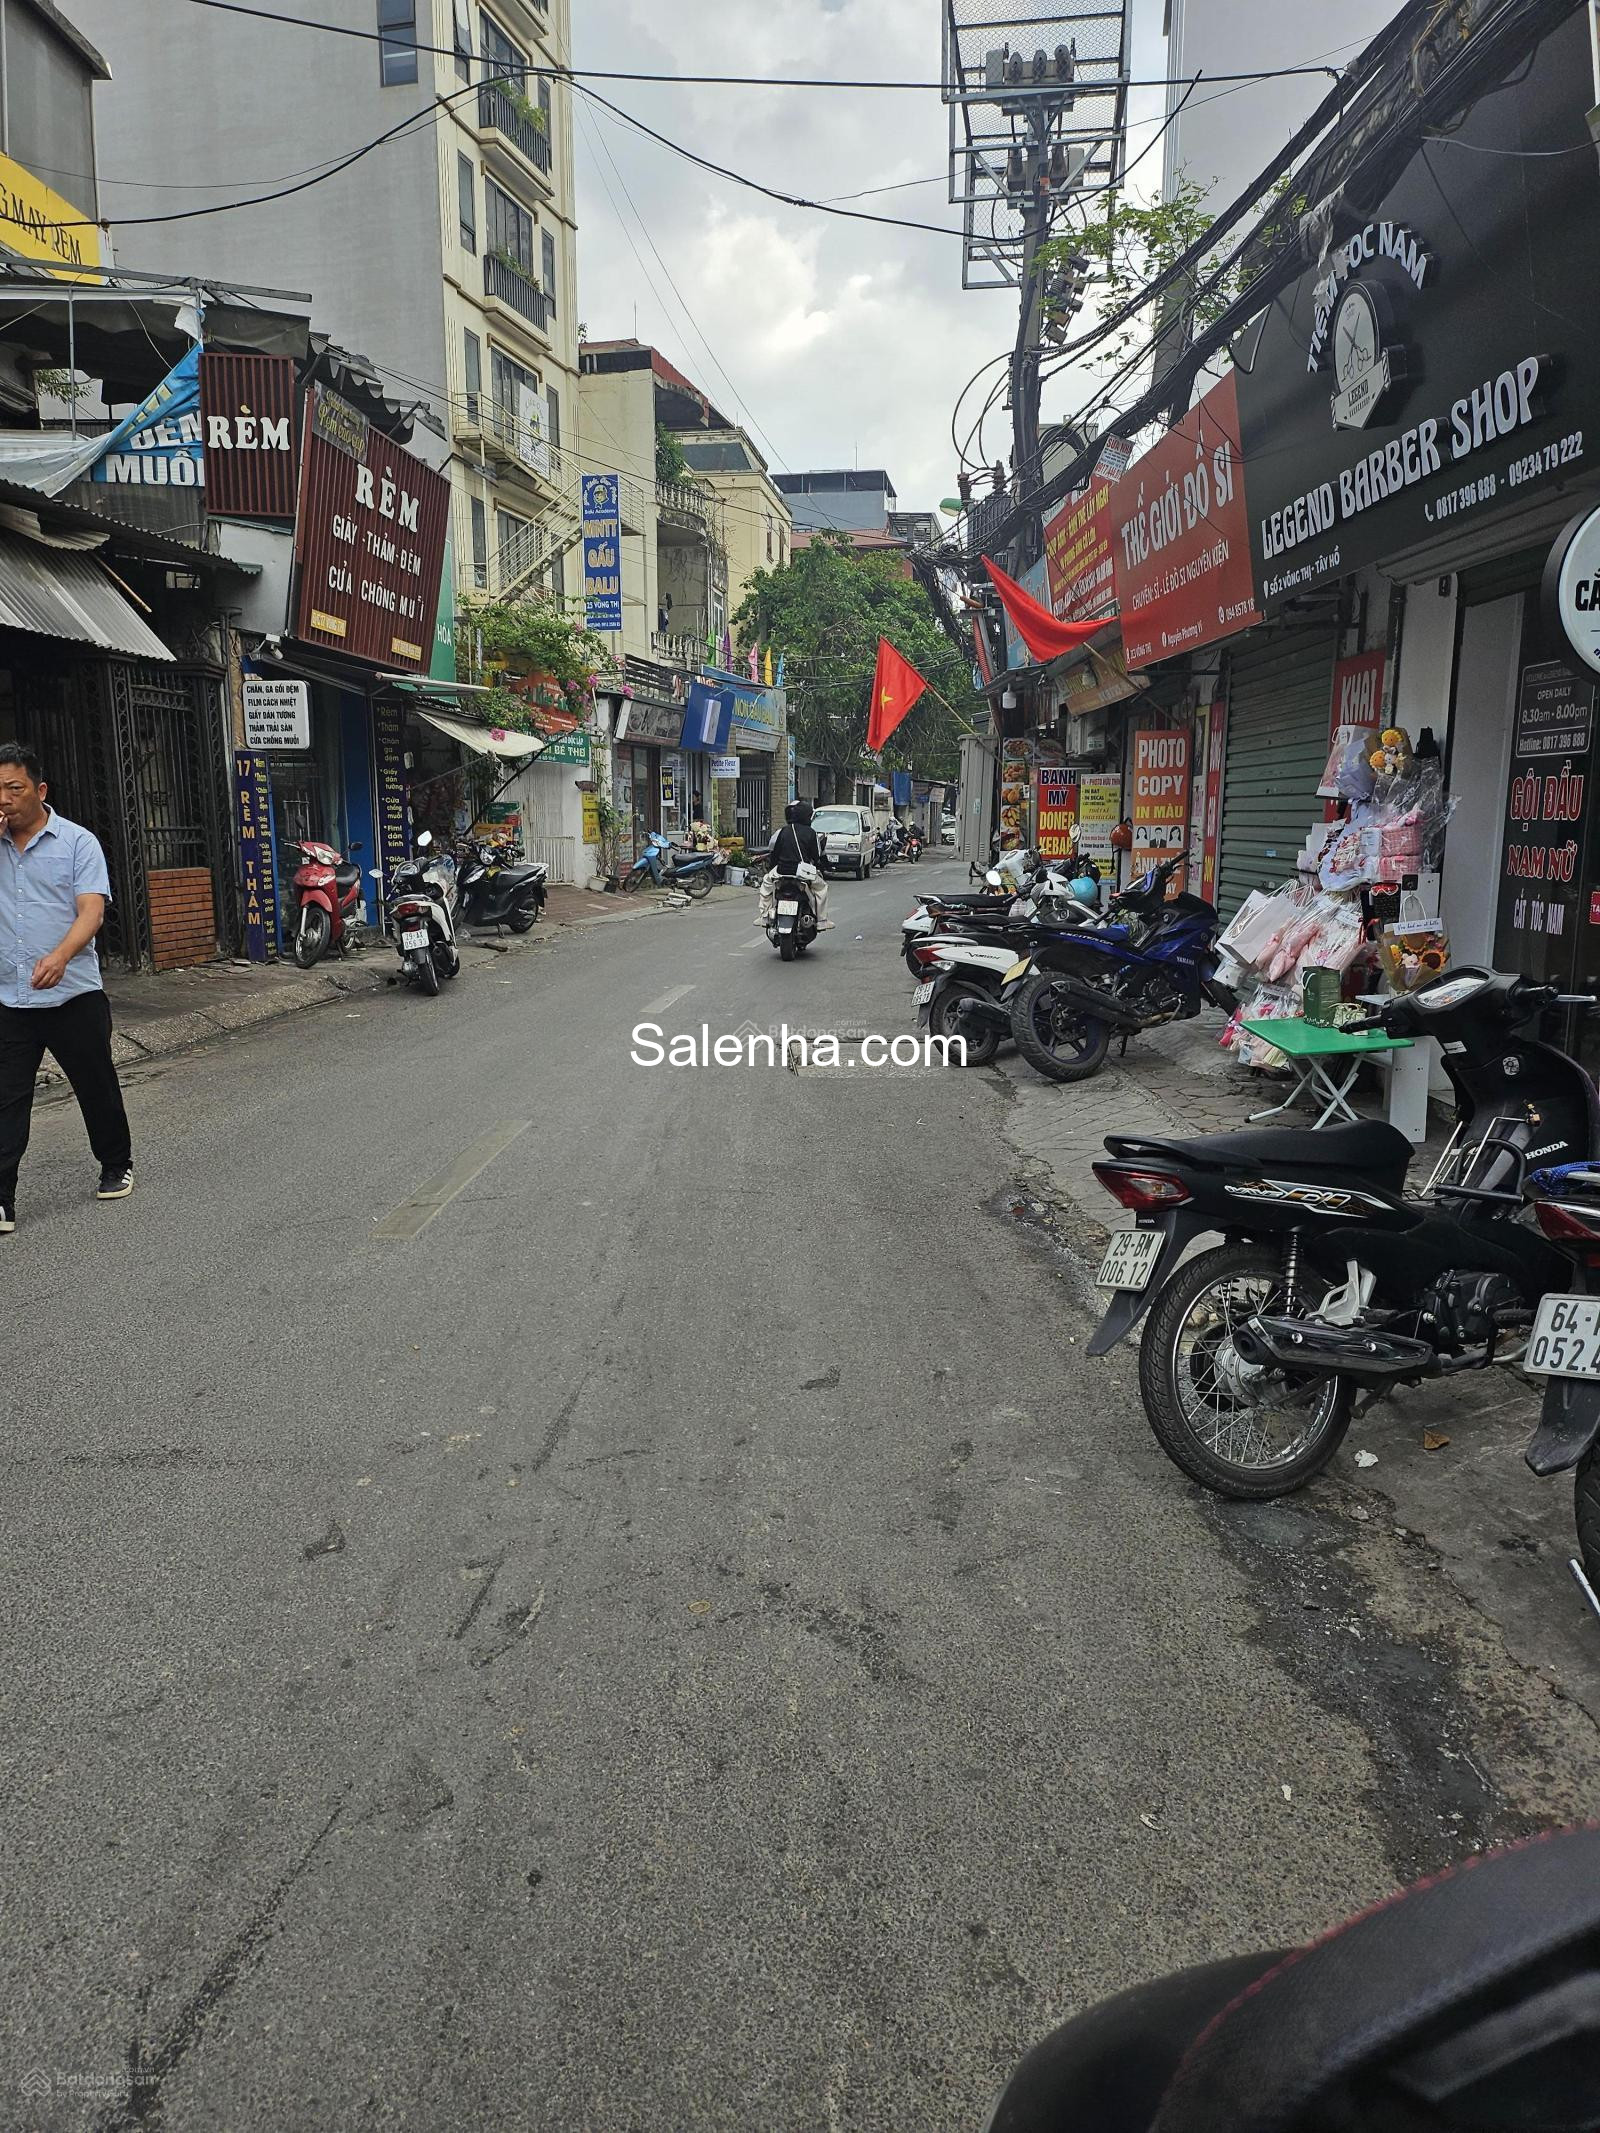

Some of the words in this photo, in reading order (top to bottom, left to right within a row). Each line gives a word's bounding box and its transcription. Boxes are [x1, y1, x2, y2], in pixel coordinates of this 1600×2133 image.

[1379, 221, 1427, 290] NAM
[1347, 379, 1369, 407] LEGEND
[207, 403, 291, 451] RÈM
[1261, 482, 1335, 560] LEGEND
[1339, 418, 1441, 519] BARBER
[1451, 356, 1540, 460] SHOP
[1436, 491, 1459, 521] 0817
[1459, 481, 1477, 509] 396
[1477, 474, 1497, 502] 888
[1509, 456, 1543, 487] 09234
[1543, 443, 1560, 472] 79
[1560, 431, 1584, 465] 222
[354, 463, 420, 533] RÈM
[1121, 482, 1149, 570] THẾ
[1149, 470, 1182, 552] GIỚI
[1213, 440, 1234, 508] SI
[585, 576, 619, 595] BALU
[1340, 668, 1377, 725] KHAI
[1537, 690, 1553, 700] OPEN
[1554, 686, 1573, 698] DAILY
[1522, 708, 1550, 724] 8.30am
[1556, 703, 1588, 720] 8.00pm
[1138, 737, 1186, 769] PHOTO
[1542, 735, 1558, 750] 0817
[237, 759, 251, 776] 17
[1137, 775, 1184, 797] COPY
[1510, 768, 1542, 832] GỘI
[1542, 760, 1584, 821] ĐẦU
[1136, 806, 1150, 819] IN
[1153, 802, 1184, 819] MÀU
[1507, 844, 1546, 879] NAM
[1546, 839, 1578, 883] NỮ
[1546, 902, 1565, 935] NAM
[1525, 1140, 1569, 1160] HONDA
[1112, 1232, 1155, 1257] 29-BM
[1100, 1261, 1149, 1286] 006.12
[1550, 1301, 1600, 1334] 64-
